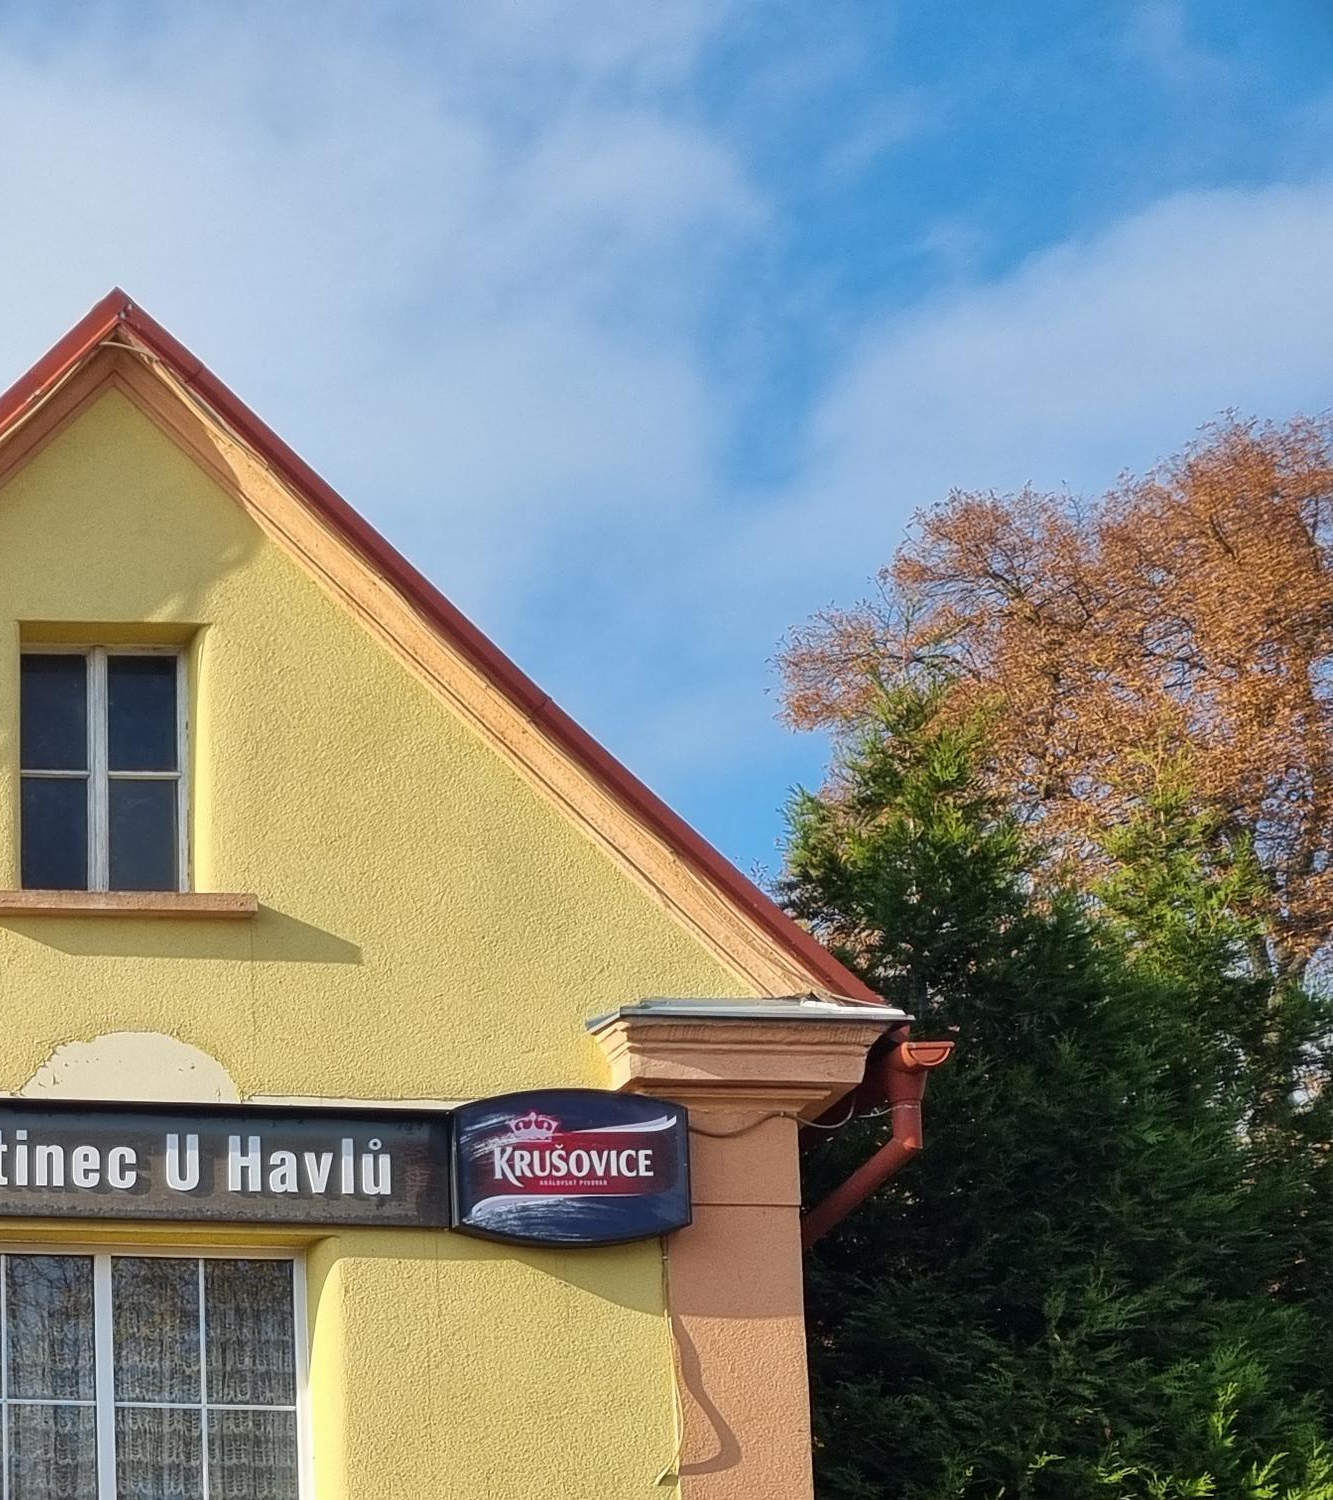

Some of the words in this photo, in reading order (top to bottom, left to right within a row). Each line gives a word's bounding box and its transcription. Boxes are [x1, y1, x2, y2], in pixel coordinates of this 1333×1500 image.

[166, 1134, 199, 1191] U
[229, 1135, 391, 1195] Havlů
[493, 1144, 654, 1187] KRUŠOVICE
